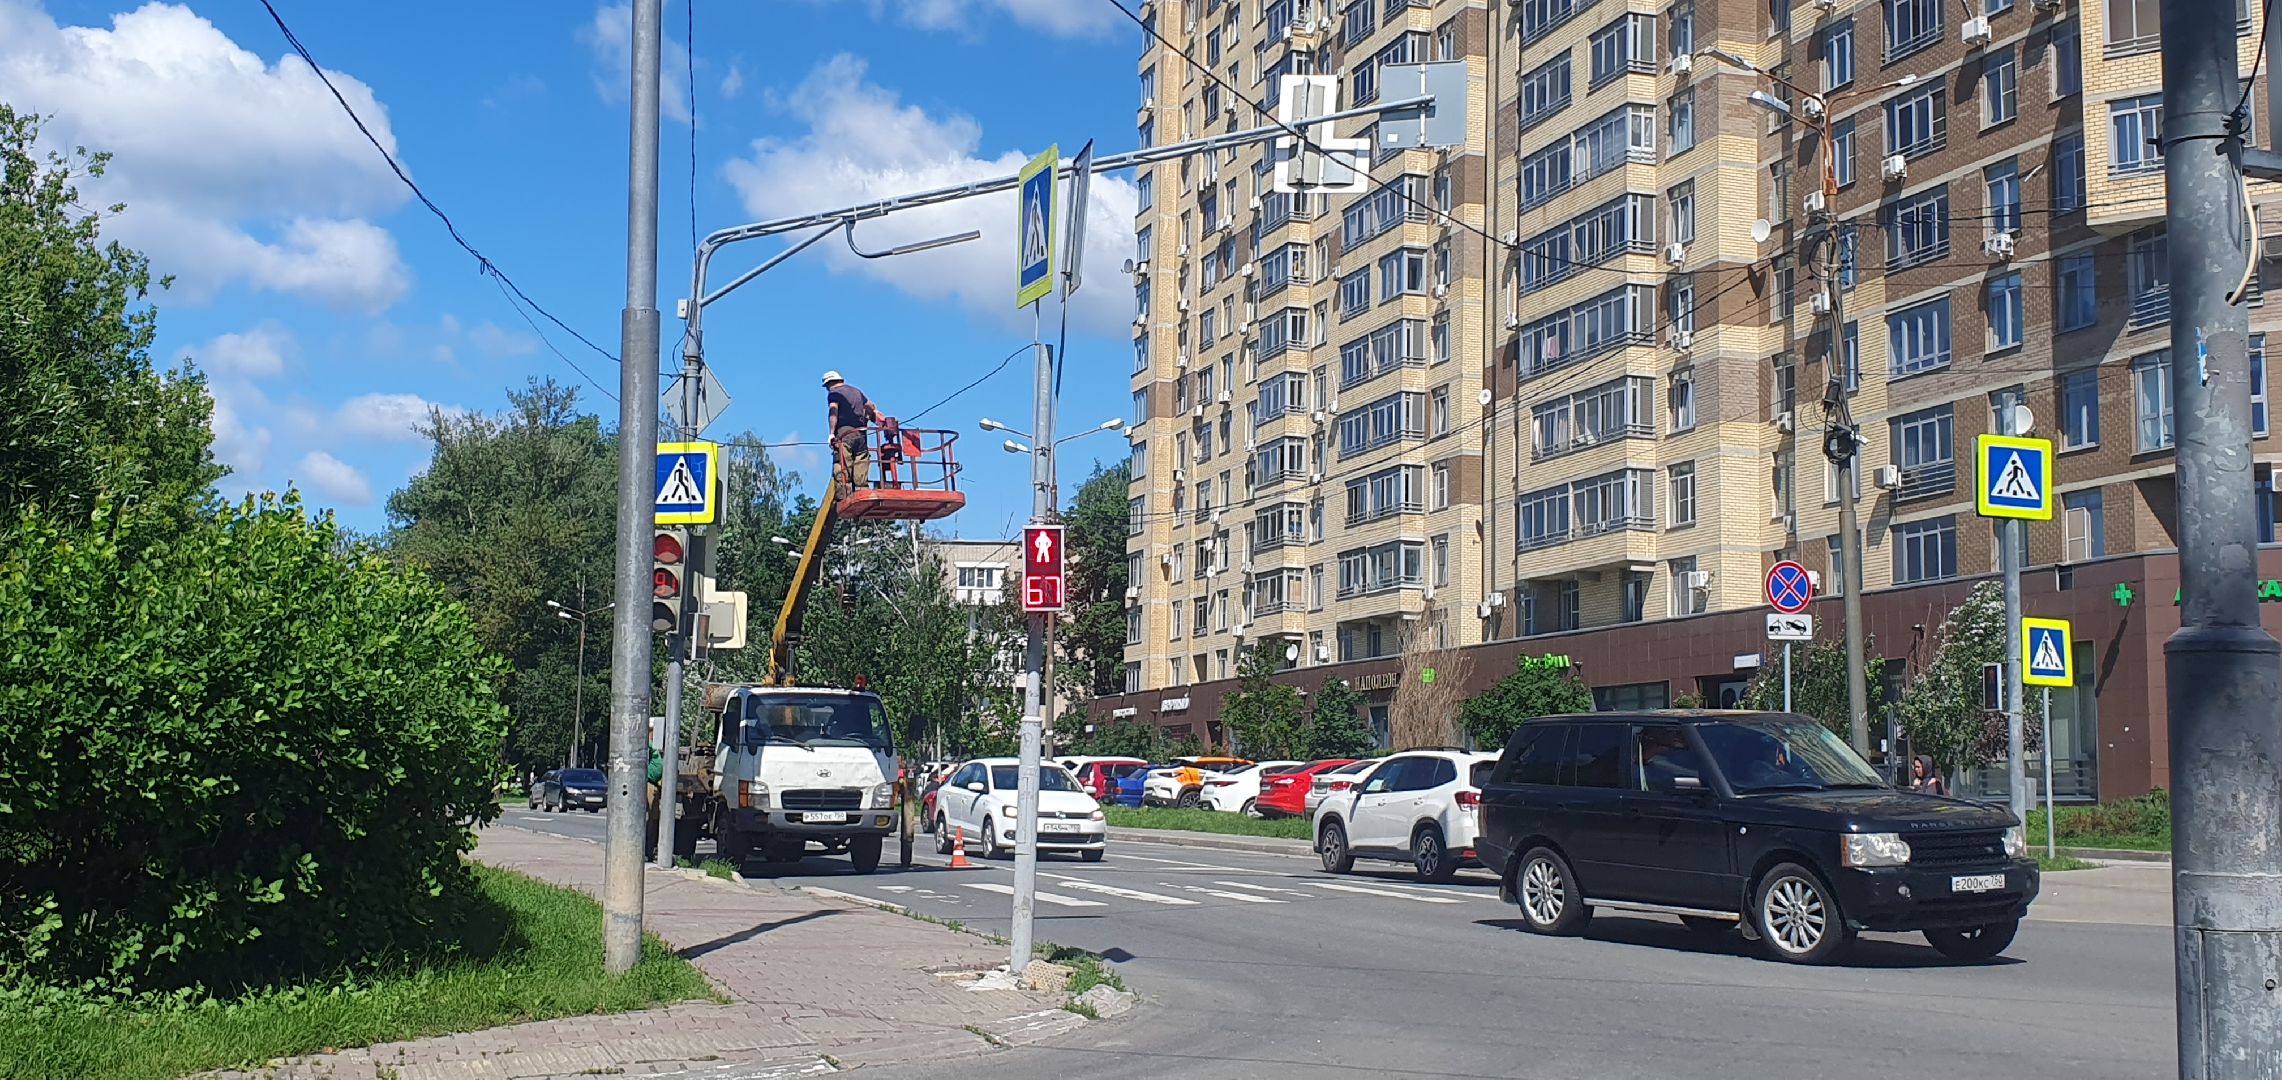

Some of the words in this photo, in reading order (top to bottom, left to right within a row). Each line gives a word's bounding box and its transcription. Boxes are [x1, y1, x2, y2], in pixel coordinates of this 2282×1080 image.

[1026, 576, 1061, 605] 67
[1353, 672, 1398, 692] НАПОЛЕОН
[1955, 877, 1989, 890] Е200КС
